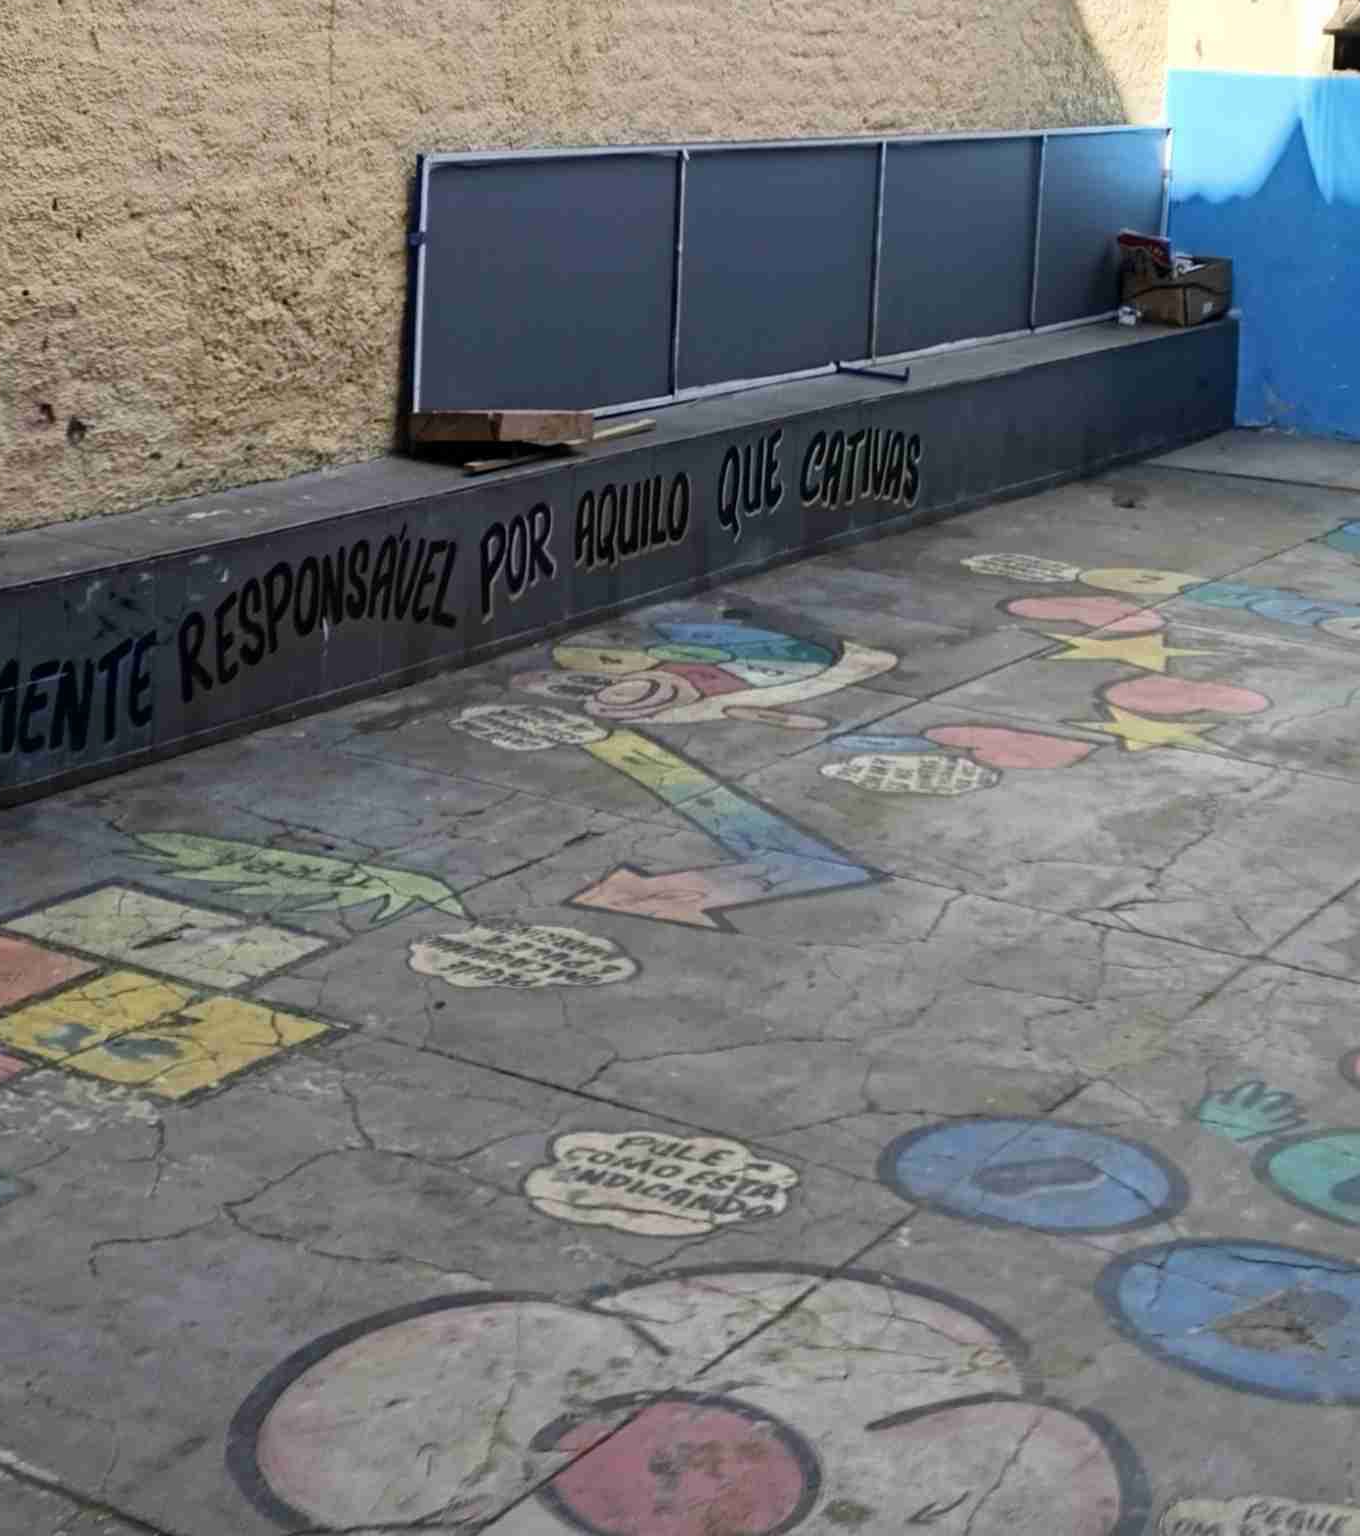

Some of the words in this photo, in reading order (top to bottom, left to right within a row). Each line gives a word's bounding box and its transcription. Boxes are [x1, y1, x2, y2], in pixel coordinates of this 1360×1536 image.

[480, 503, 558, 624] POR
[575, 470, 691, 572] AQUILO
[717, 427, 785, 544] QUE
[800, 426, 922, 510] CATIVAS
[563, 1146, 683, 1180] COMO
